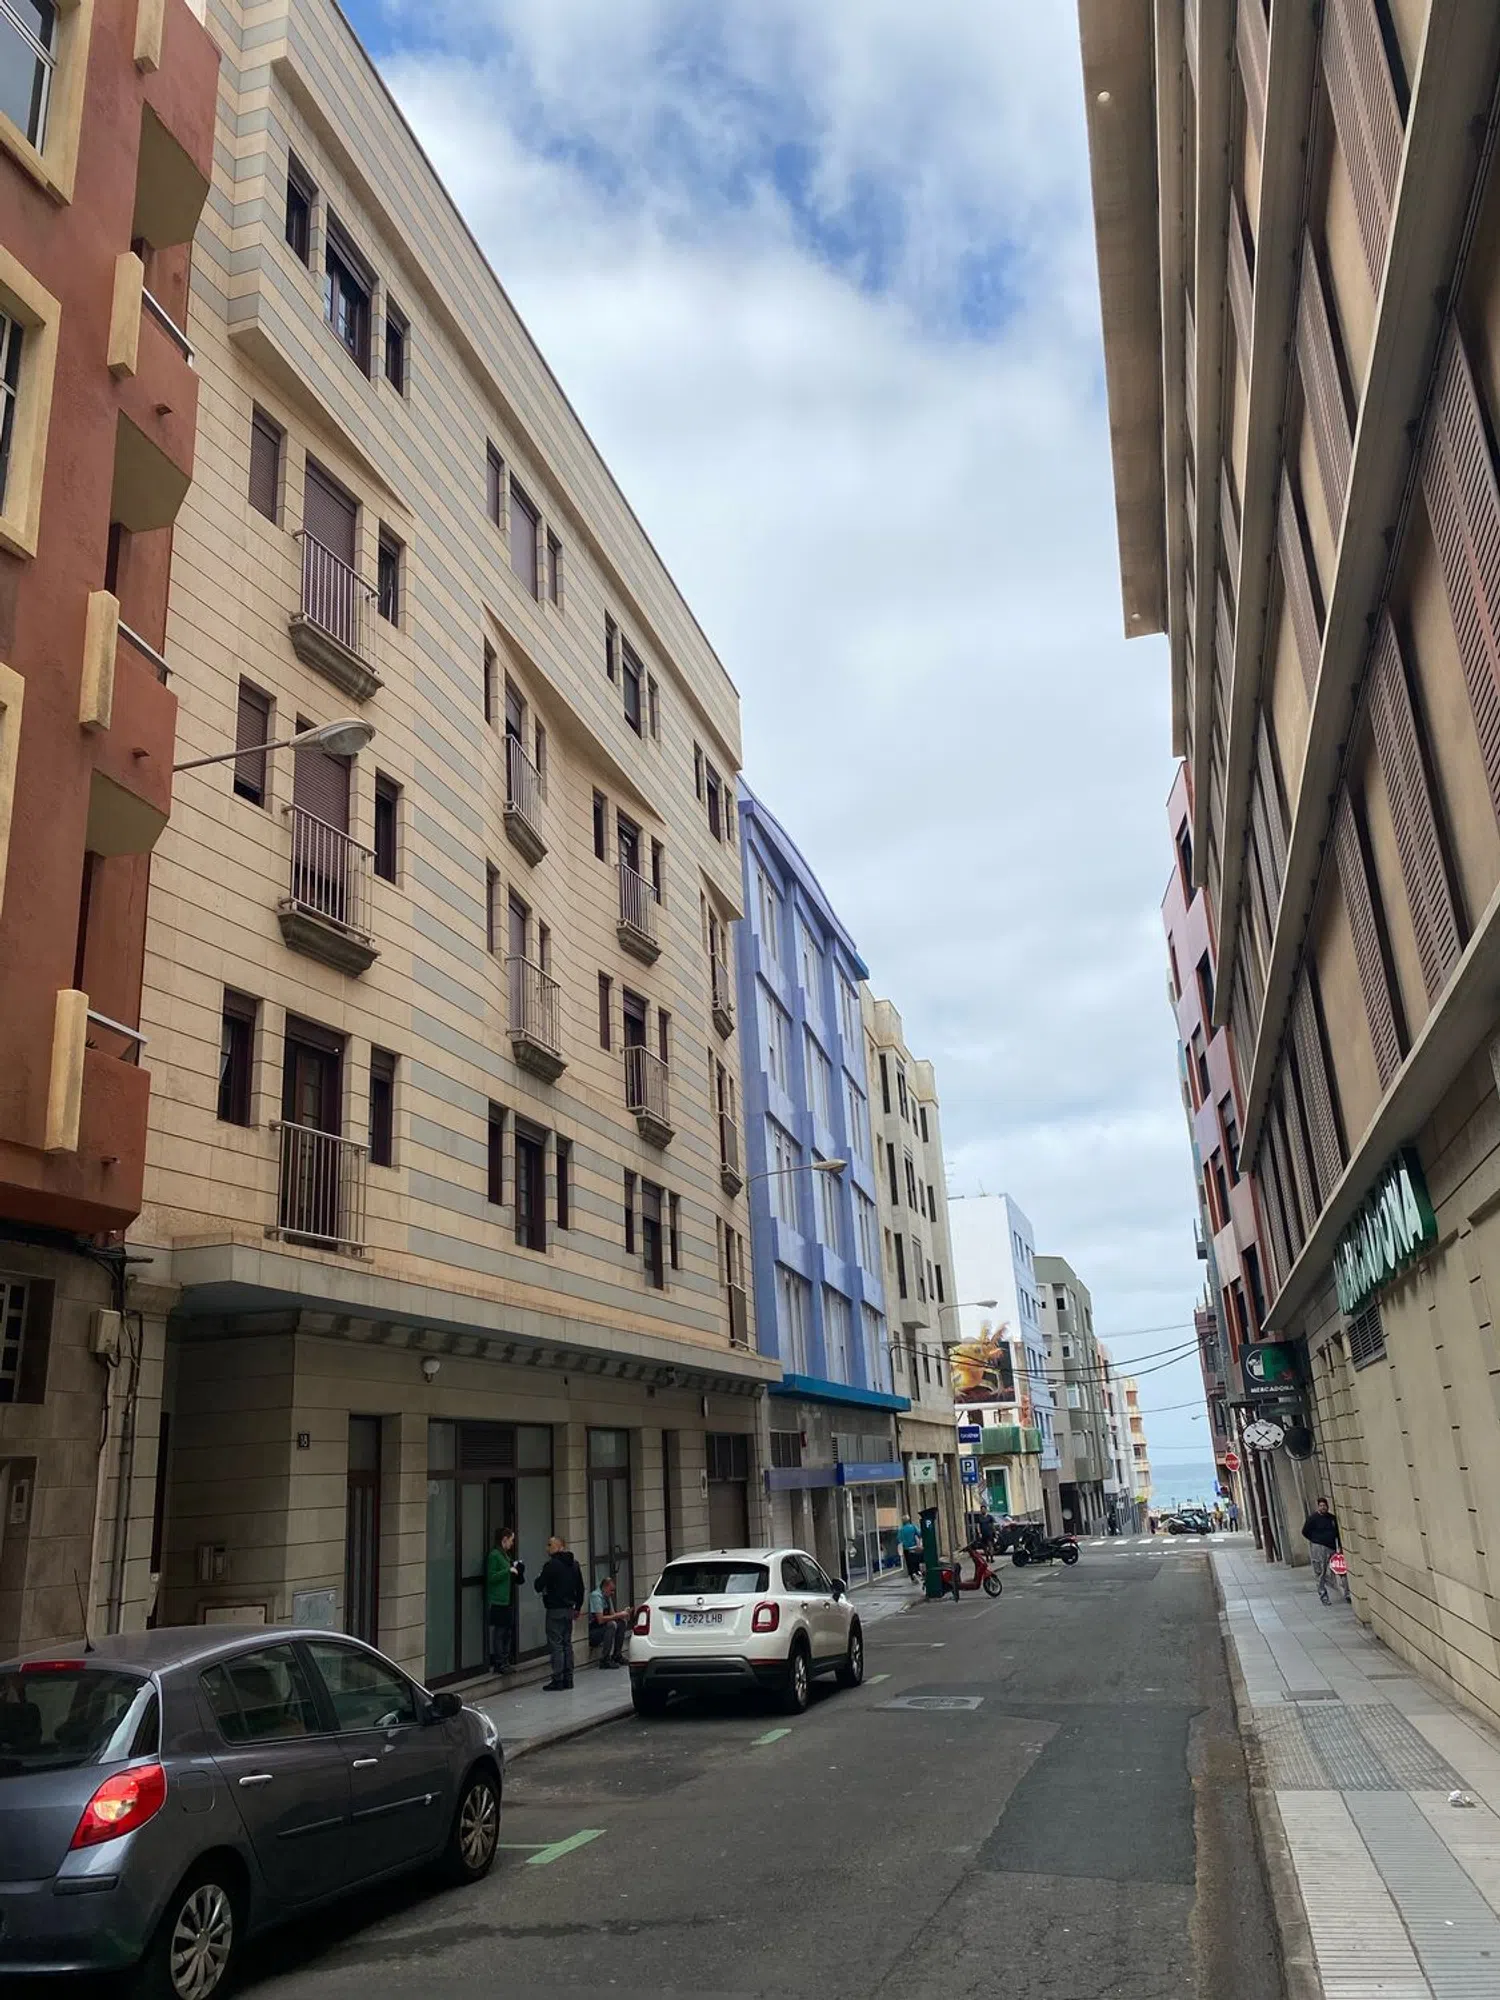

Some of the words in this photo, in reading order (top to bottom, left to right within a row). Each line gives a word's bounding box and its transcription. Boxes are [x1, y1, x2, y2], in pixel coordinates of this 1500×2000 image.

[1333, 1167, 1424, 1314] MERCADONA
[1250, 1385, 1296, 1394] MERCADONA
[964, 1461, 972, 1471] P
[925, 1519, 932, 1528] P
[705, 1613, 723, 1624] LHB
